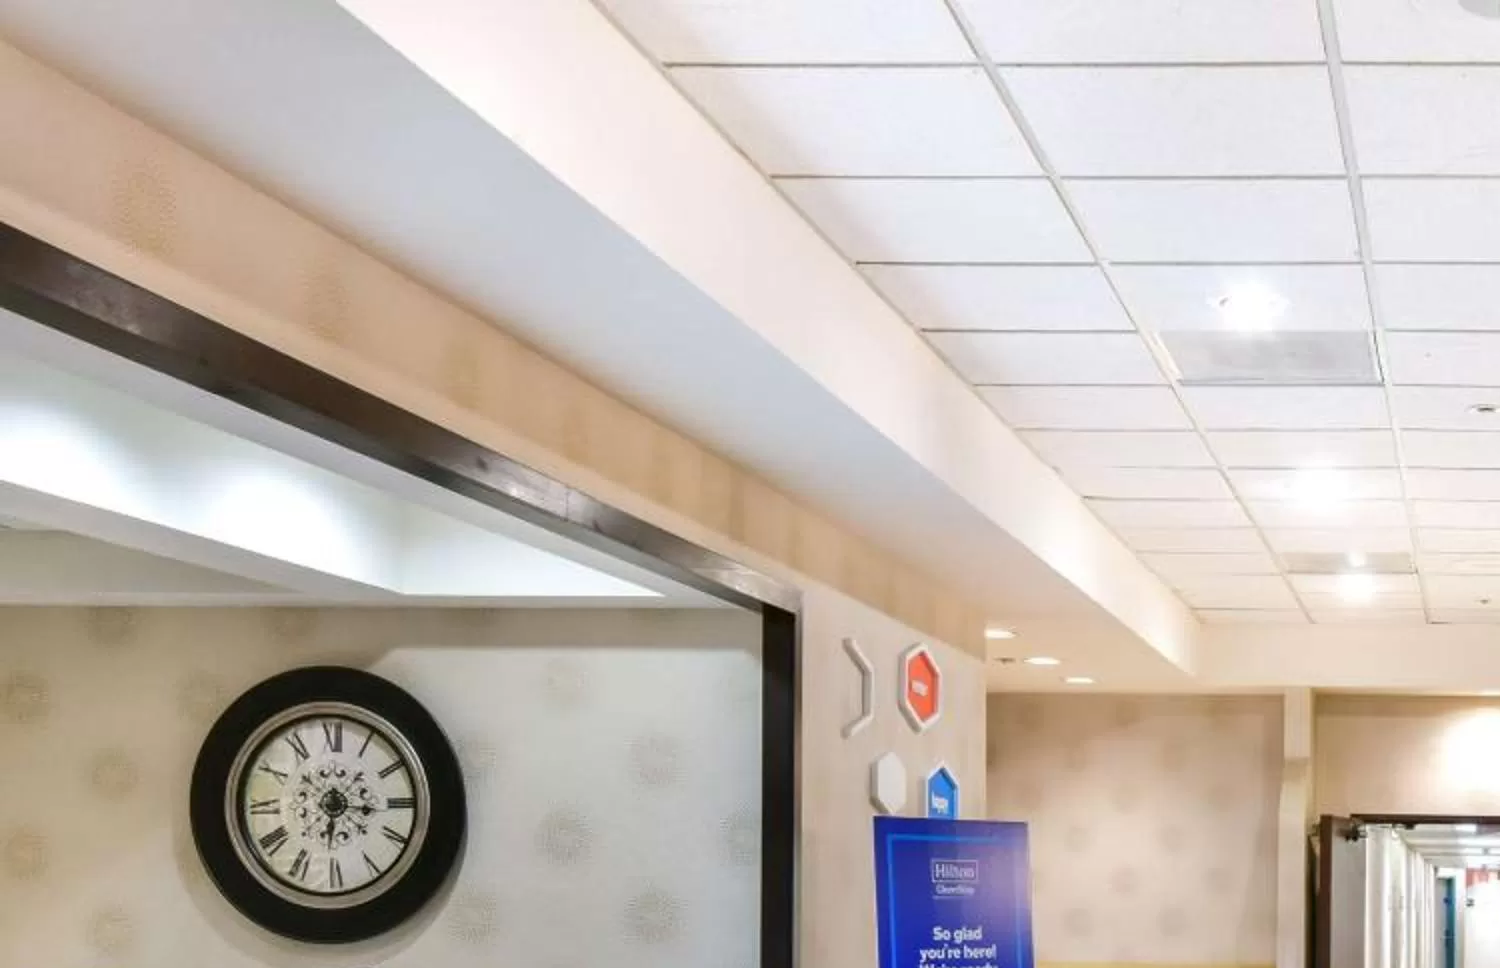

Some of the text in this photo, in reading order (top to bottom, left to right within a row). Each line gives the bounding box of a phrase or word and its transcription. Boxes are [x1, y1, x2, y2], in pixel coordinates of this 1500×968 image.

[935, 863, 975, 878] Hilton
[933, 926, 983, 944] So glad
[919, 944, 997, 963] you're here!
